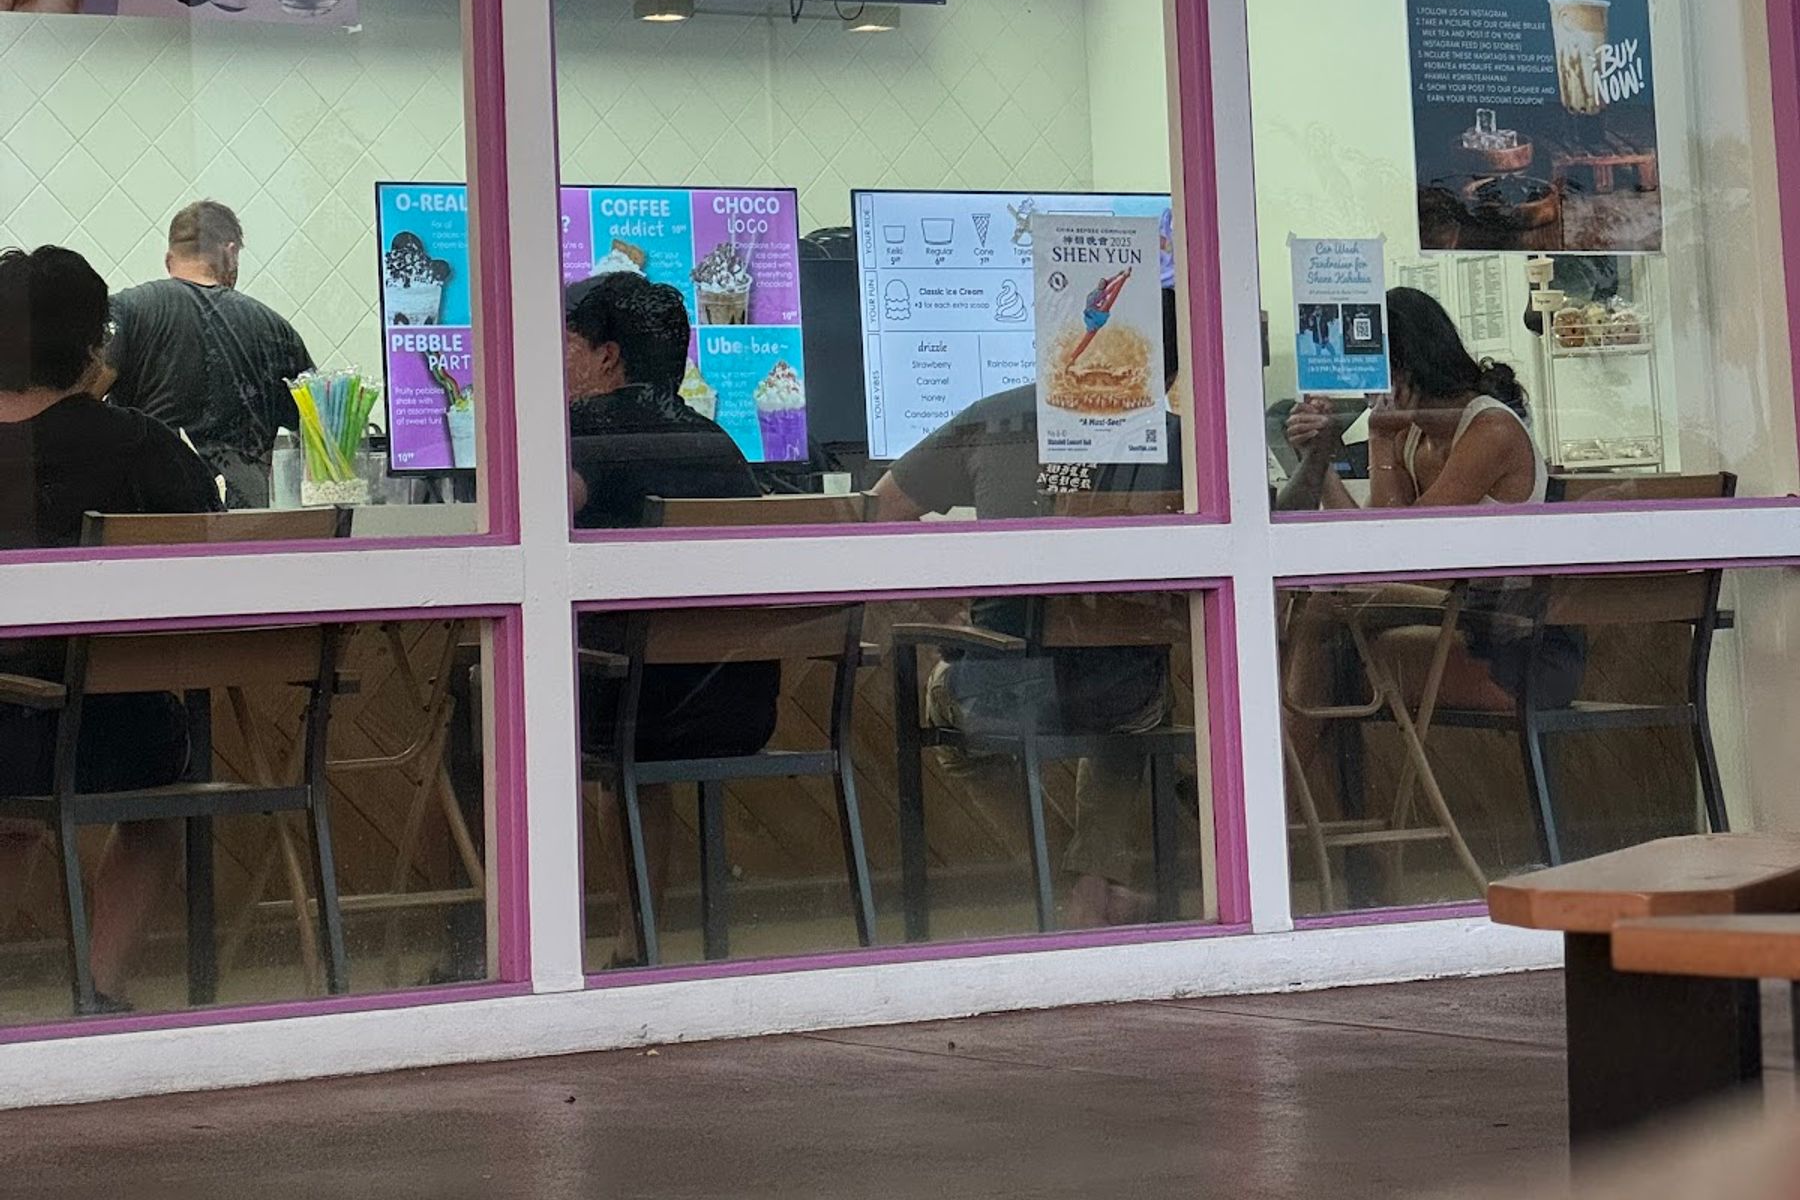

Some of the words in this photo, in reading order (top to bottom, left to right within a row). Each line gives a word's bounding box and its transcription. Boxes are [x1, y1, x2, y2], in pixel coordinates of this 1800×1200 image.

[1595, 38, 1638, 79] BUY
[1592, 57, 1645, 106] NOW!
[601, 198, 671, 217] COFFEE
[712, 196, 780, 214] CHOCO
[609, 220, 665, 238] addict
[727, 218, 768, 234] LOCO
[1109, 236, 1132, 247] 2025
[925, 247, 954, 257] Regular
[973, 247, 995, 256] Cone
[1051, 246, 1100, 263] SHEN
[1105, 248, 1142, 264] YUN
[918, 287, 945, 296] Classic
[946, 287, 958, 295] Ice
[959, 287, 984, 296] Cream
[970, 302, 991, 310] scoop
[391, 334, 463, 353] PEBBLE
[918, 341, 948, 353] drizzle
[911, 360, 952, 371] Strawberry
[987, 359, 1019, 368] Rainbow
[872, 369, 881, 397] VIBES
[916, 377, 950, 386] Caramel
[1001, 376, 1022, 385] Oreo
[920, 393, 947, 403] Honey
[874, 397, 883, 420] YOUR
[904, 409, 950, 419] Condensed
